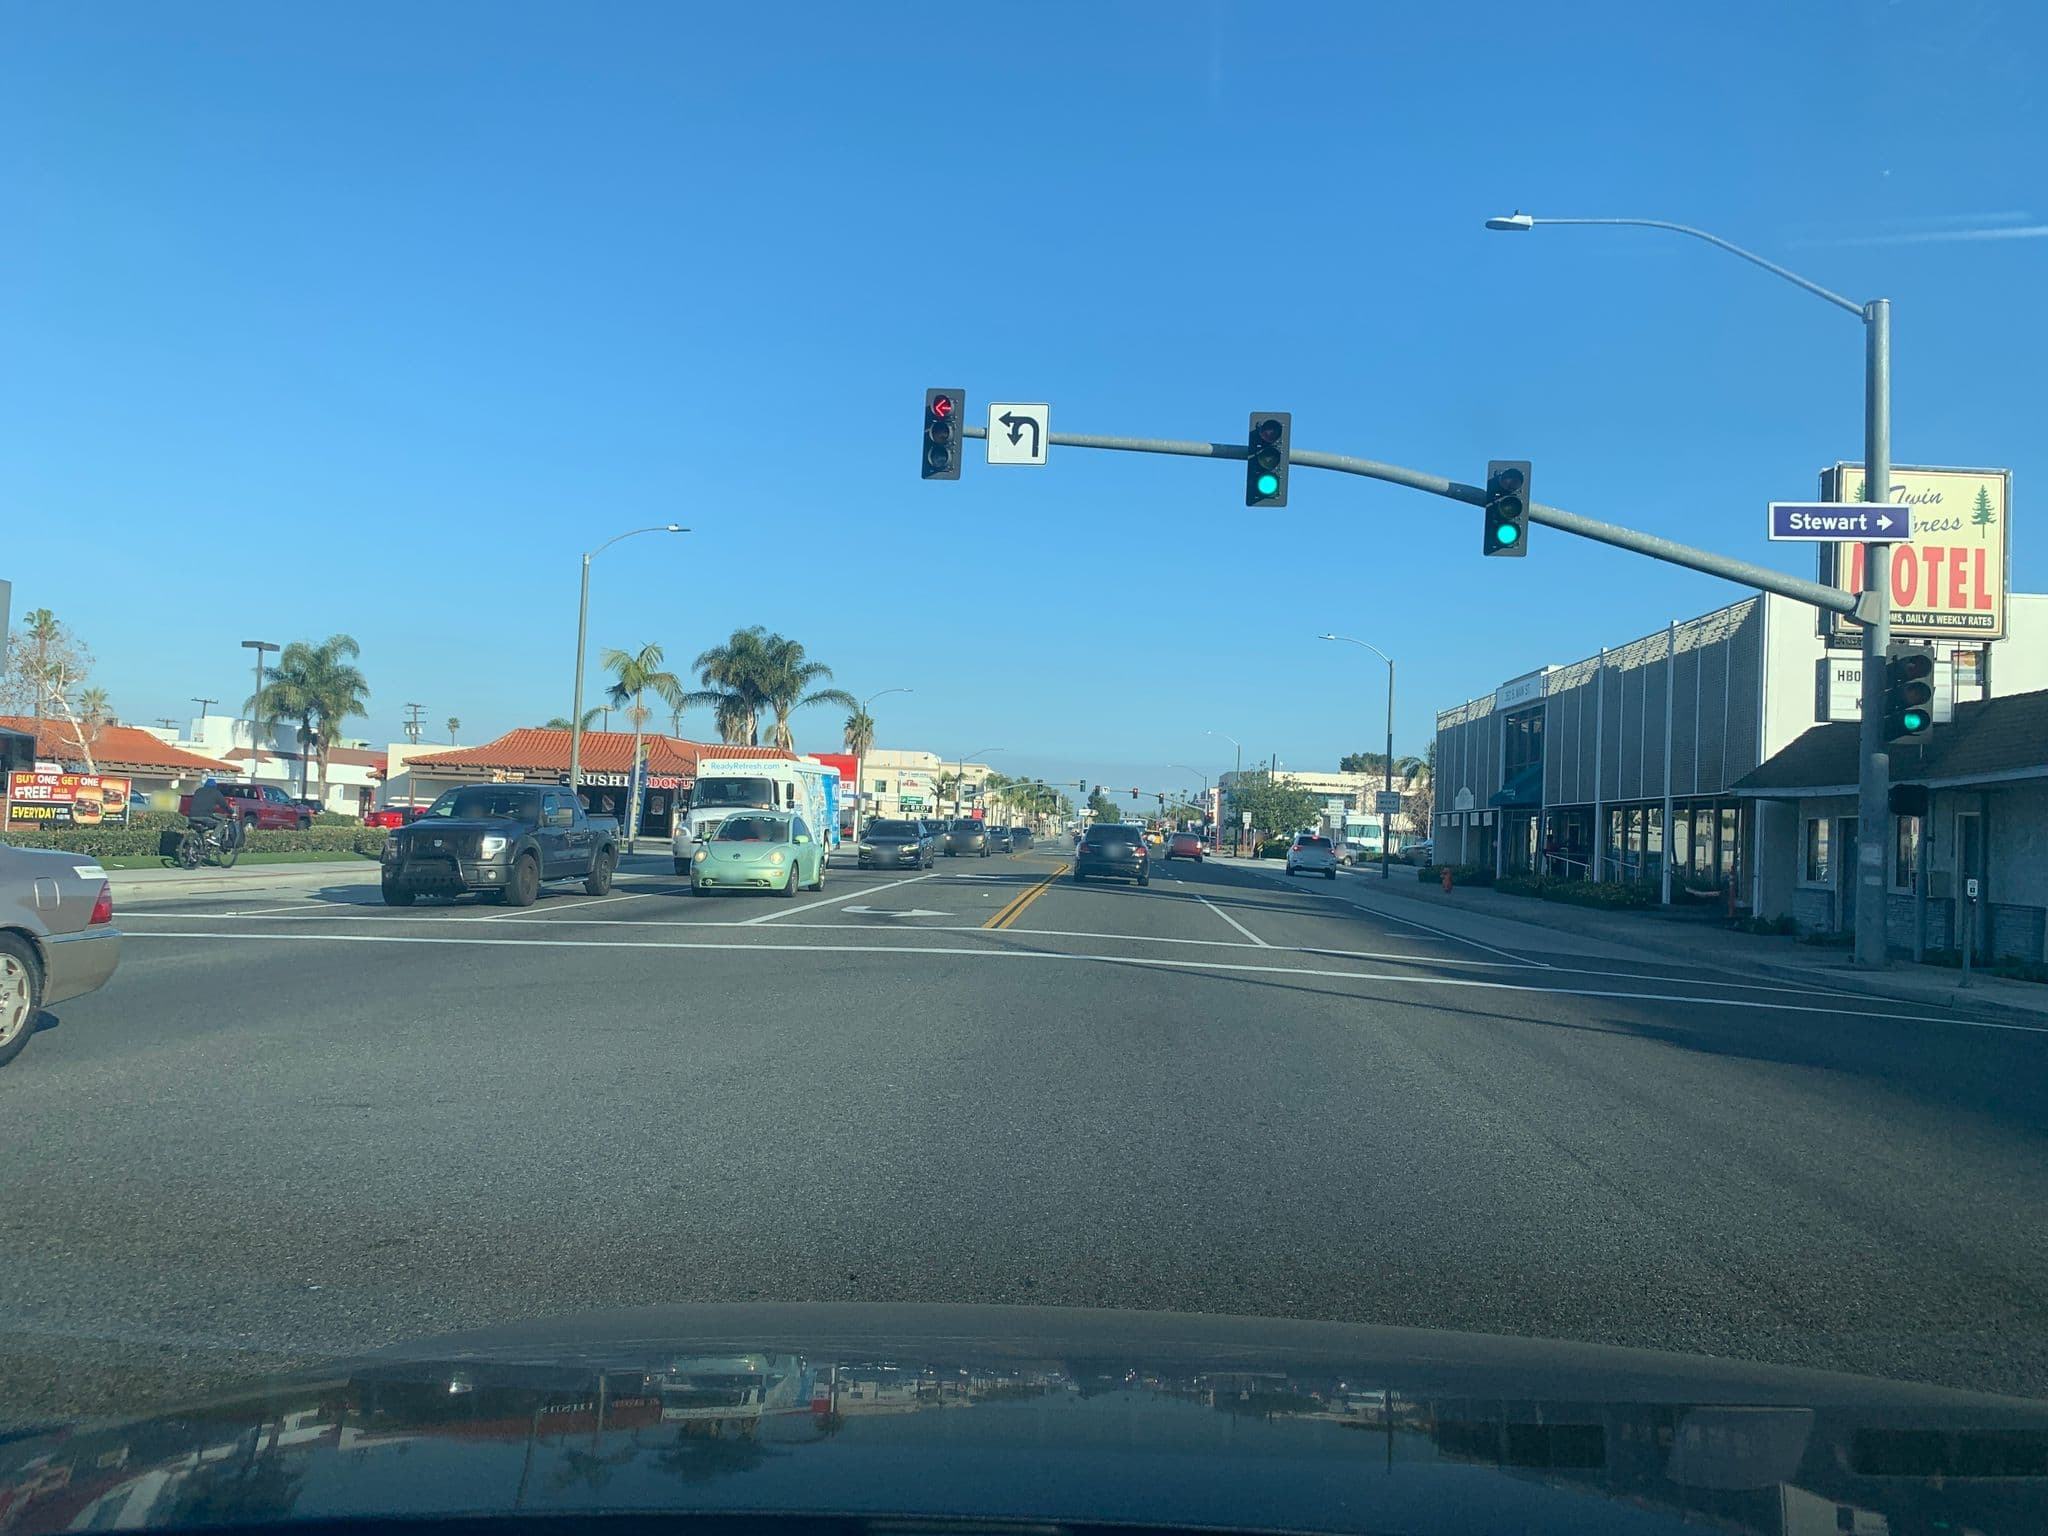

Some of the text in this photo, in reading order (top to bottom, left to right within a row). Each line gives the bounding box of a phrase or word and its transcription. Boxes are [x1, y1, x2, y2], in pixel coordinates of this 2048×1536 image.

[1889, 485, 1943, 504] Twin
[1790, 513, 1868, 530] Stewart
[1914, 515, 1963, 532] ress
[1906, 614, 1928, 624] DAILY
[1929, 615, 1936, 624] &
[1936, 615, 1967, 626] WEEKLY
[1968, 617, 1993, 626] RATES
[1838, 670, 1861, 682] HBO
[16, 775, 99, 787] BUY ONE, GET ONE
[577, 774, 629, 786] SUSHI
[15, 786, 51, 799] FREE!
[12, 806, 56, 819] EVERYDAY
